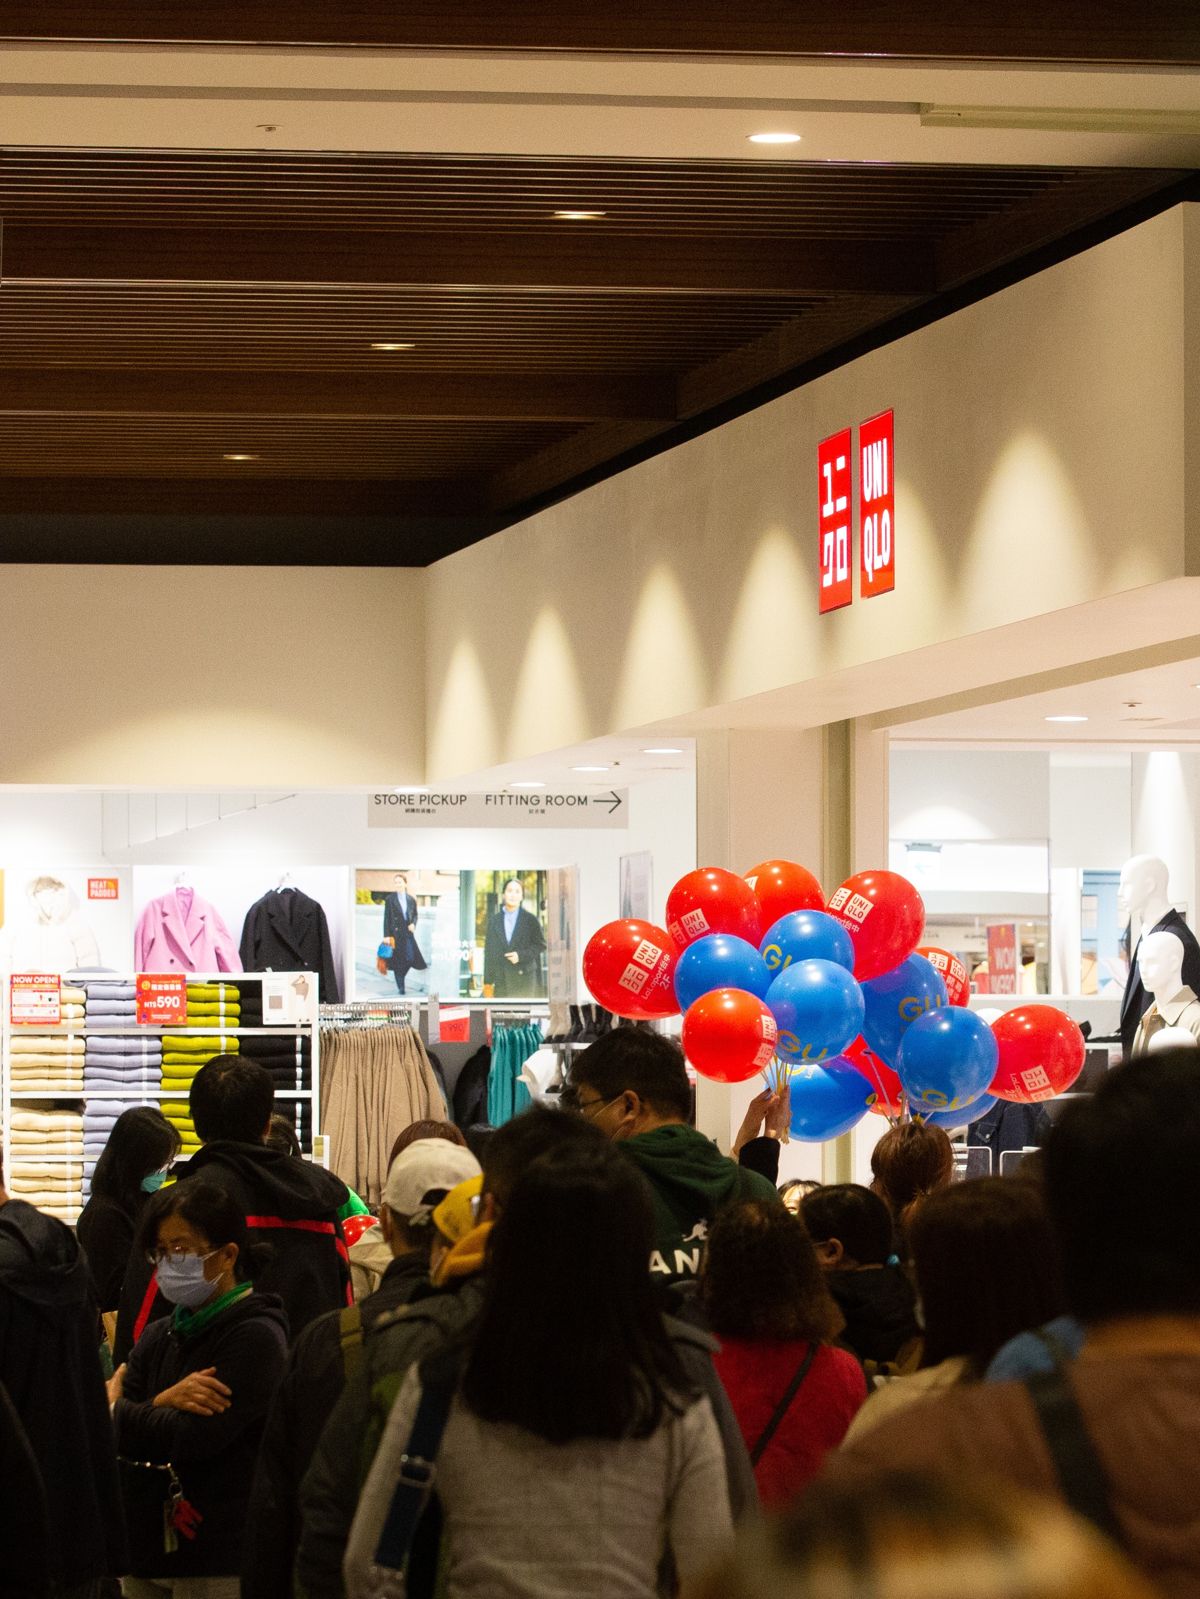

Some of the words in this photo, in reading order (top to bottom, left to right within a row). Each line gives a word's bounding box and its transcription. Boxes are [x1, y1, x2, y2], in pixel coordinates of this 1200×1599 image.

[374, 794, 414, 805] STORE
[419, 794, 467, 805] PICKUP
[485, 795, 540, 806] FITTING
[545, 795, 588, 806] ROOM
[12, 976, 33, 985] NOW
[776, 1030, 829, 1062] GU
